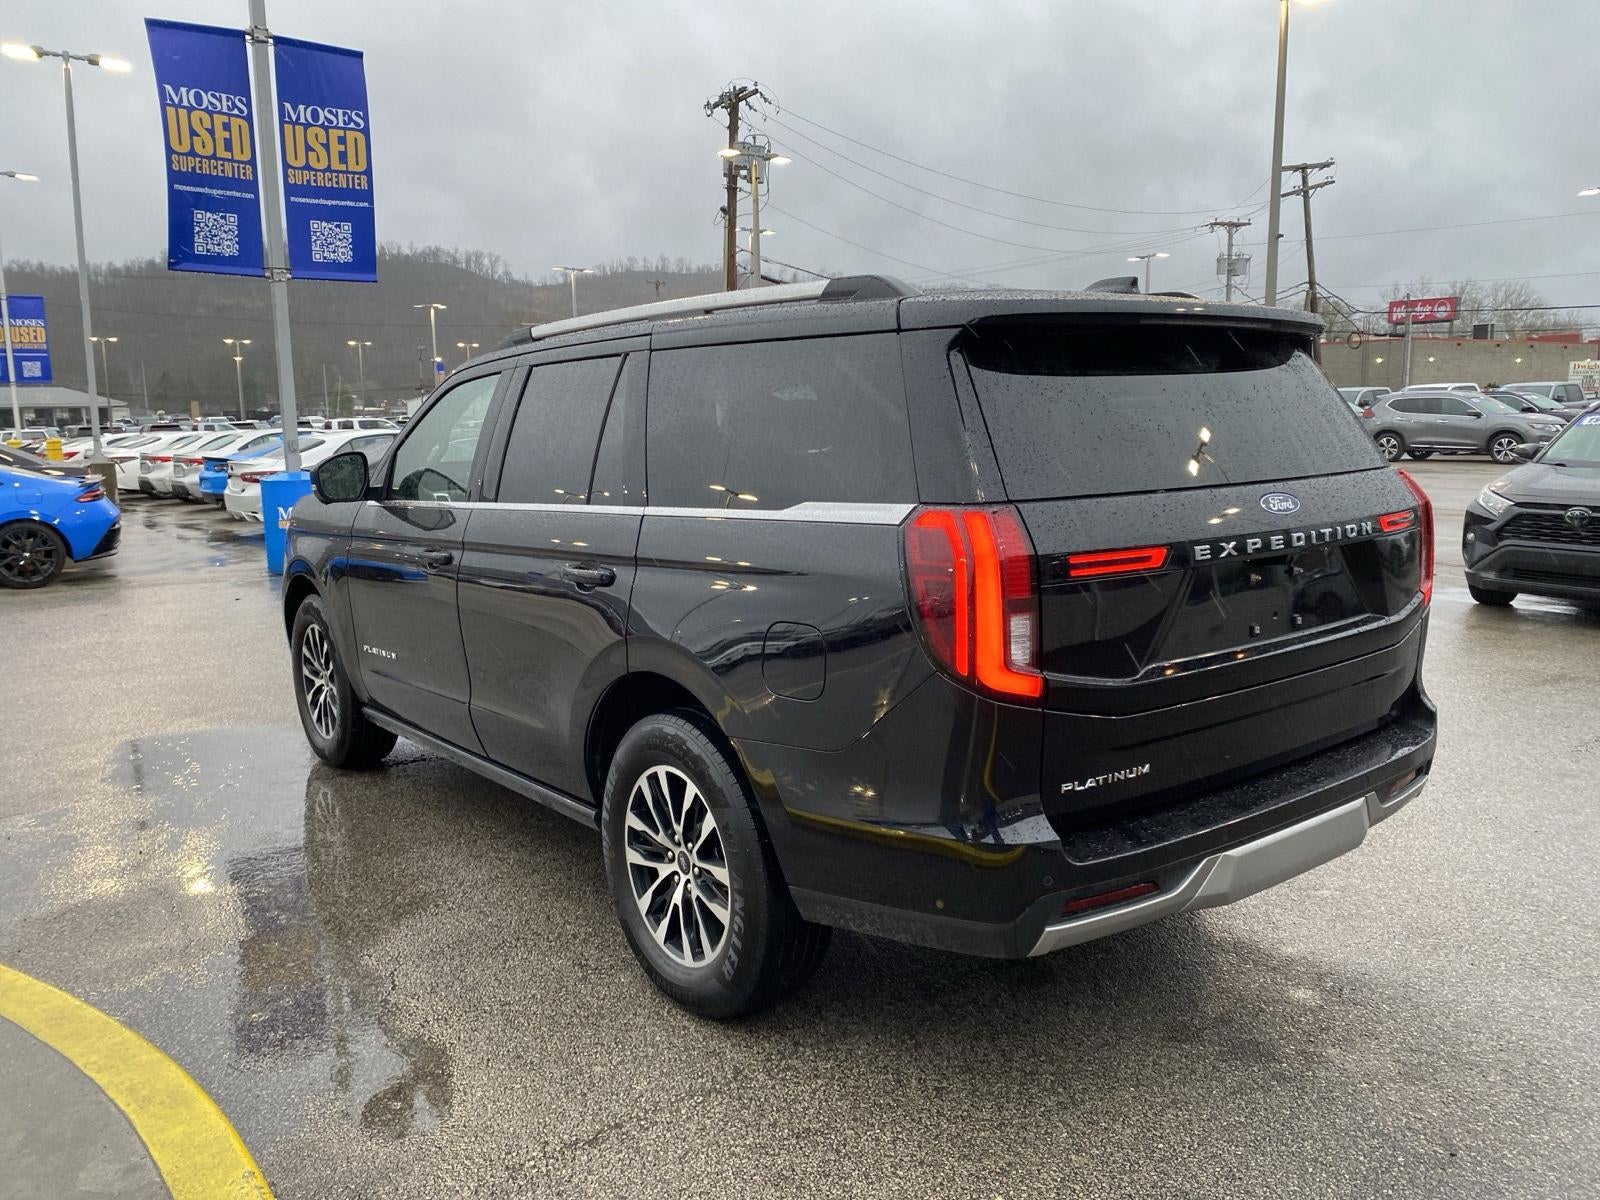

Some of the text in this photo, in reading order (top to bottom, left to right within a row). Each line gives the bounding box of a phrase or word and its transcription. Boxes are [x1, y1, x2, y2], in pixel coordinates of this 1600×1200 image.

[163, 84, 248, 117] MOSES
[282, 102, 364, 129] MOSES
[166, 106, 252, 162] USED
[284, 124, 367, 172] USED
[171, 154, 253, 180] SUPERCENTER
[287, 168, 368, 190] SUPERCENTER
[173, 184, 255, 199] mosesusedsupercenter.com
[290, 196, 369, 207] mosesusedsupercenter.com
[9, 319, 45, 327] MOSES
[11, 326, 47, 342] USED
[1269, 496, 1295, 510] Ford
[1194, 521, 1373, 561] EXPEDITION
[363, 644, 397, 660] PLATINUM
[1061, 763, 1151, 794] PLATINUM
